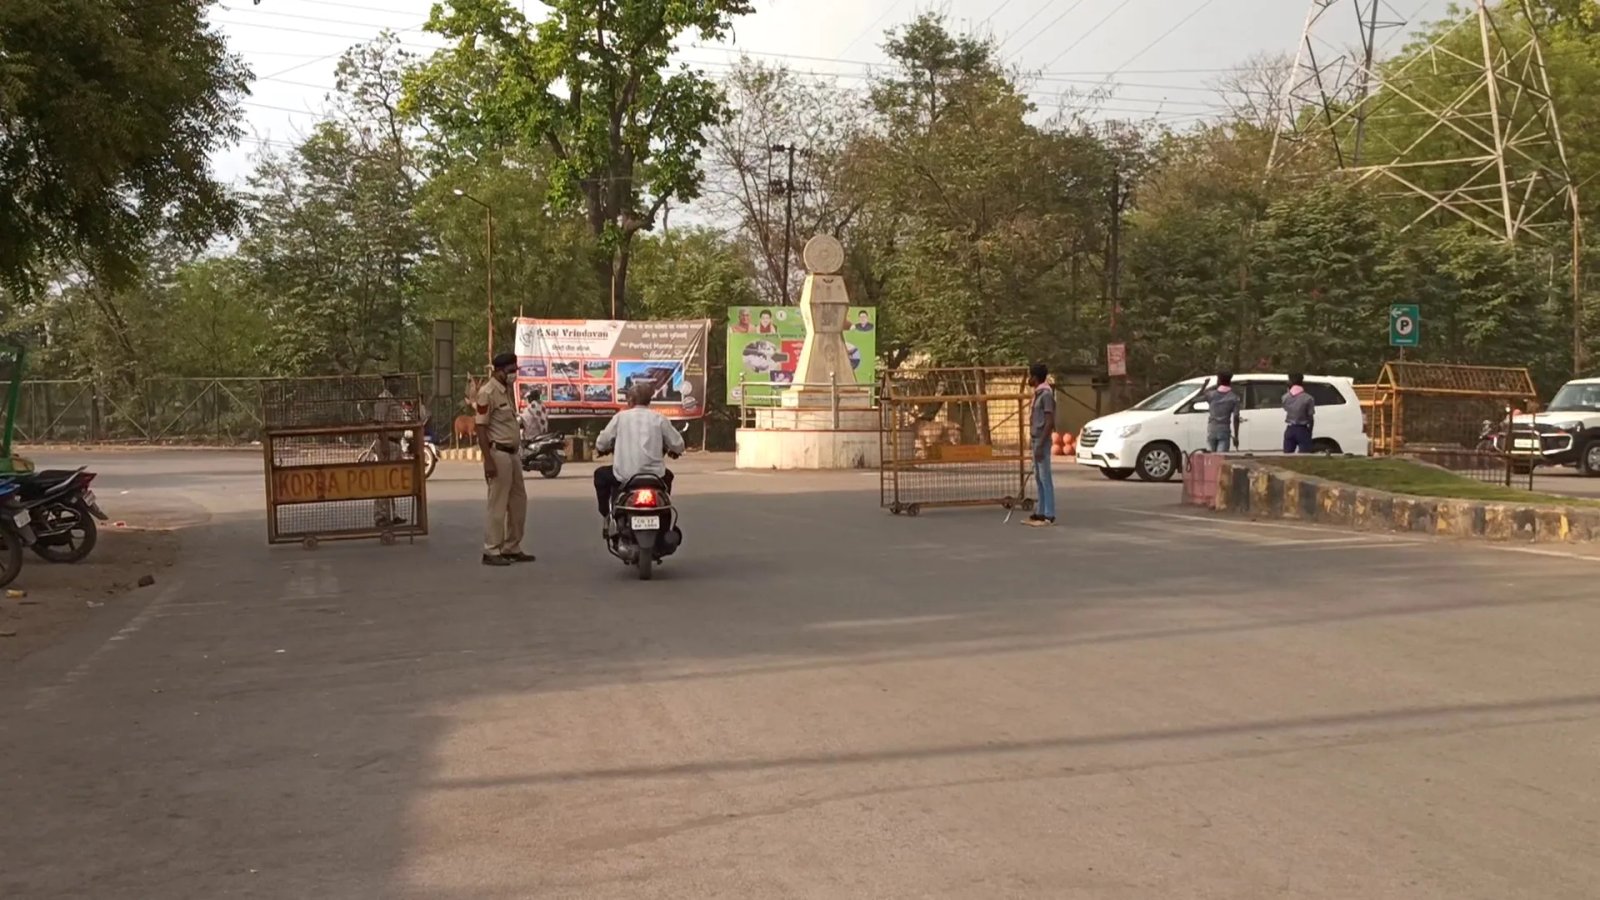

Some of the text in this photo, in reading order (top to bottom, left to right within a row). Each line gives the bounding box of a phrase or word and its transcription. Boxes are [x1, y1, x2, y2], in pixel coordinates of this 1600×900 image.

[1400, 320, 1410, 331] P
[545, 328, 559, 337] Sai
[562, 328, 609, 338] Vrindavan
[279, 467, 412, 497] KORBA POLICE
